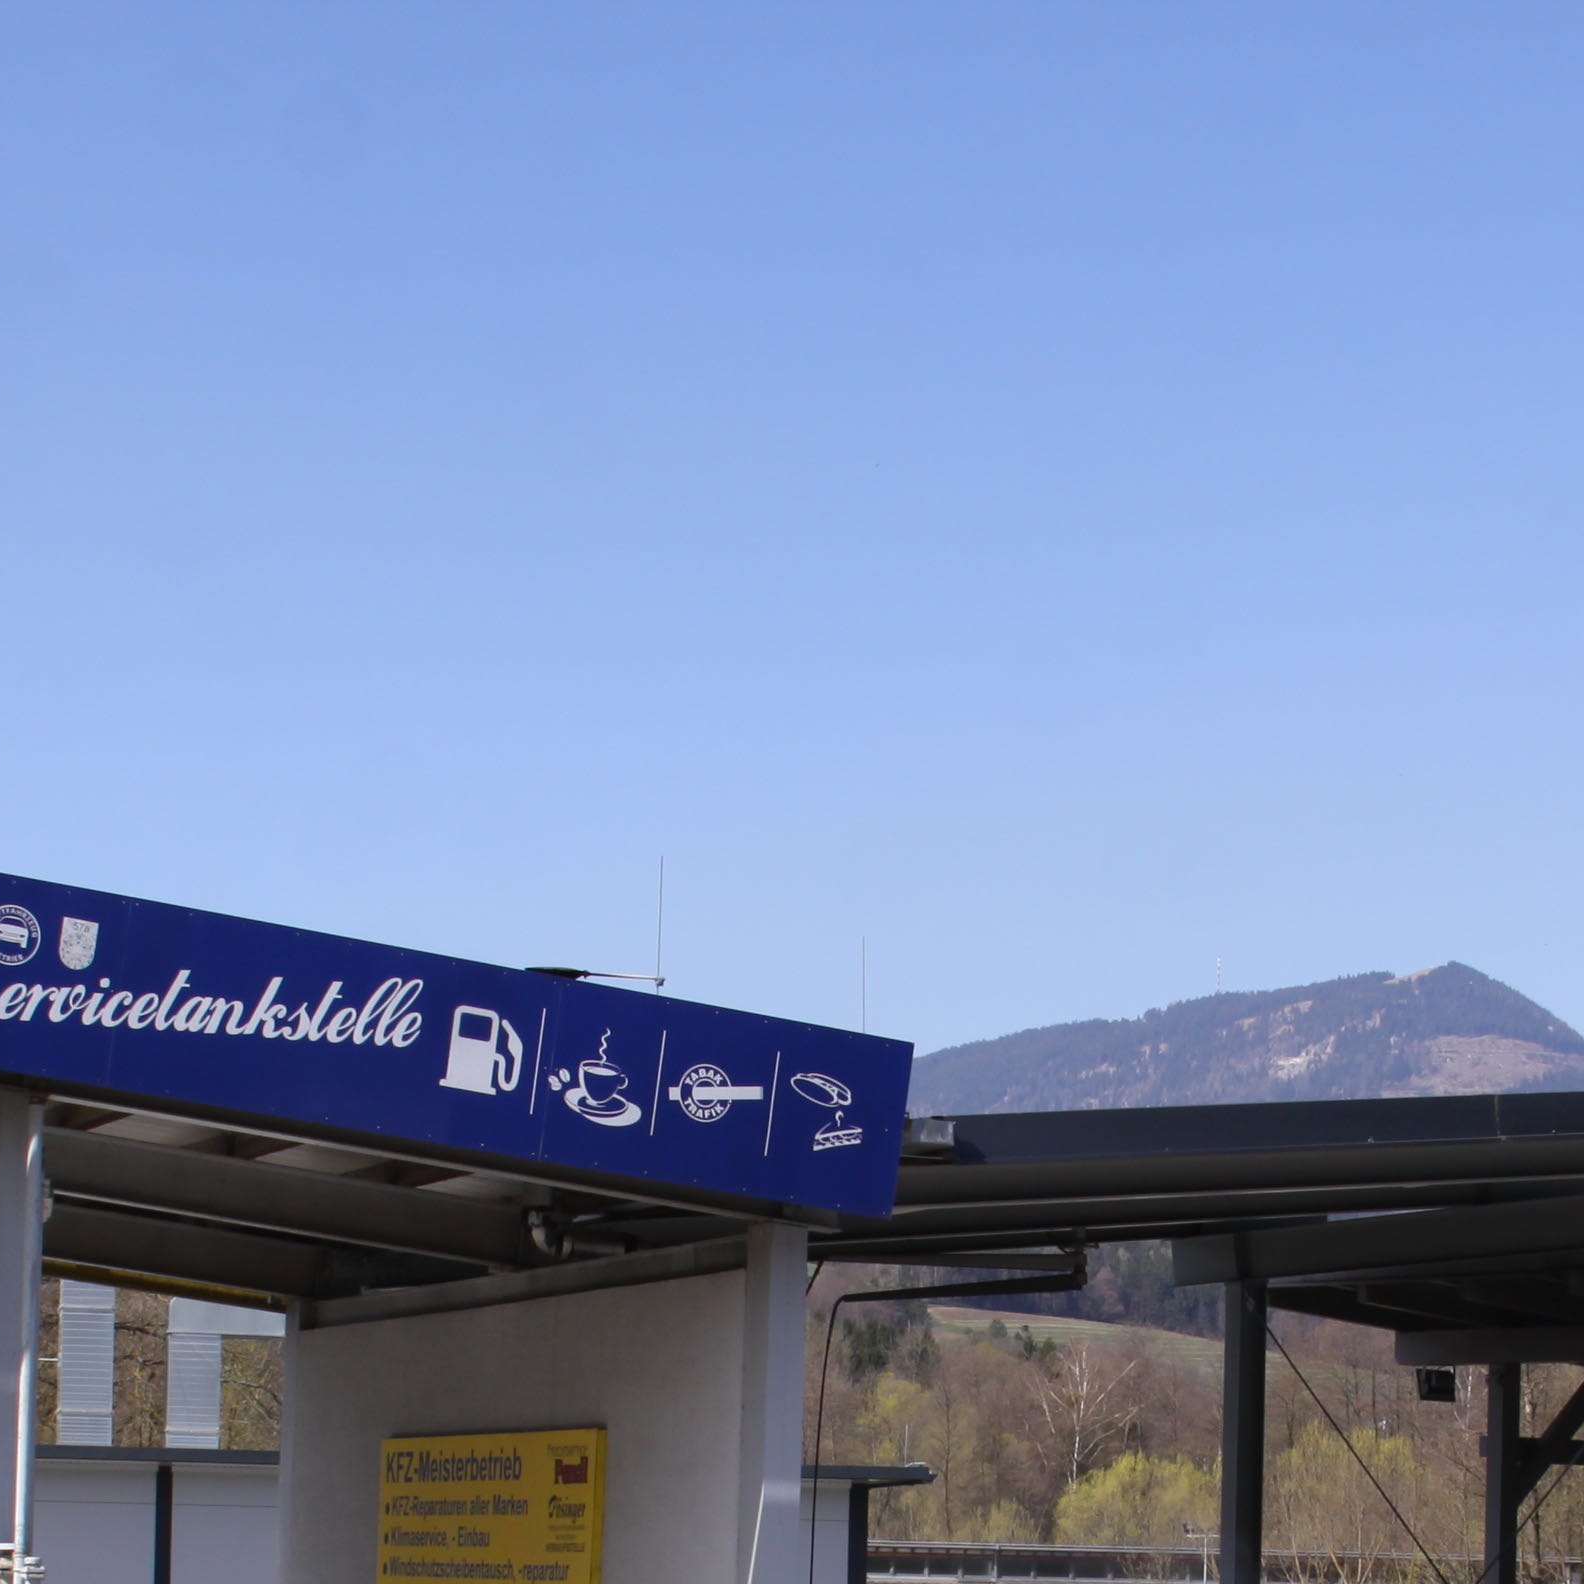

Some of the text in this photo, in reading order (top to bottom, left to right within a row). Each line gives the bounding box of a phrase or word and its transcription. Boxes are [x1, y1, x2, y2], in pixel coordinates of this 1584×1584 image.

[684, 1068, 724, 1086] TABAK
[684, 1096, 726, 1119] TRAFIK
[386, 1447, 522, 1484] KFZ-Meisterbetrieb
[391, 1494, 529, 1520] KFZ-Reparaturen aller Marken
[390, 1526, 450, 1549] Klimaservice,
[457, 1526, 491, 1548] Einbau
[388, 1556, 516, 1582] Windschutzscheibentausch,
